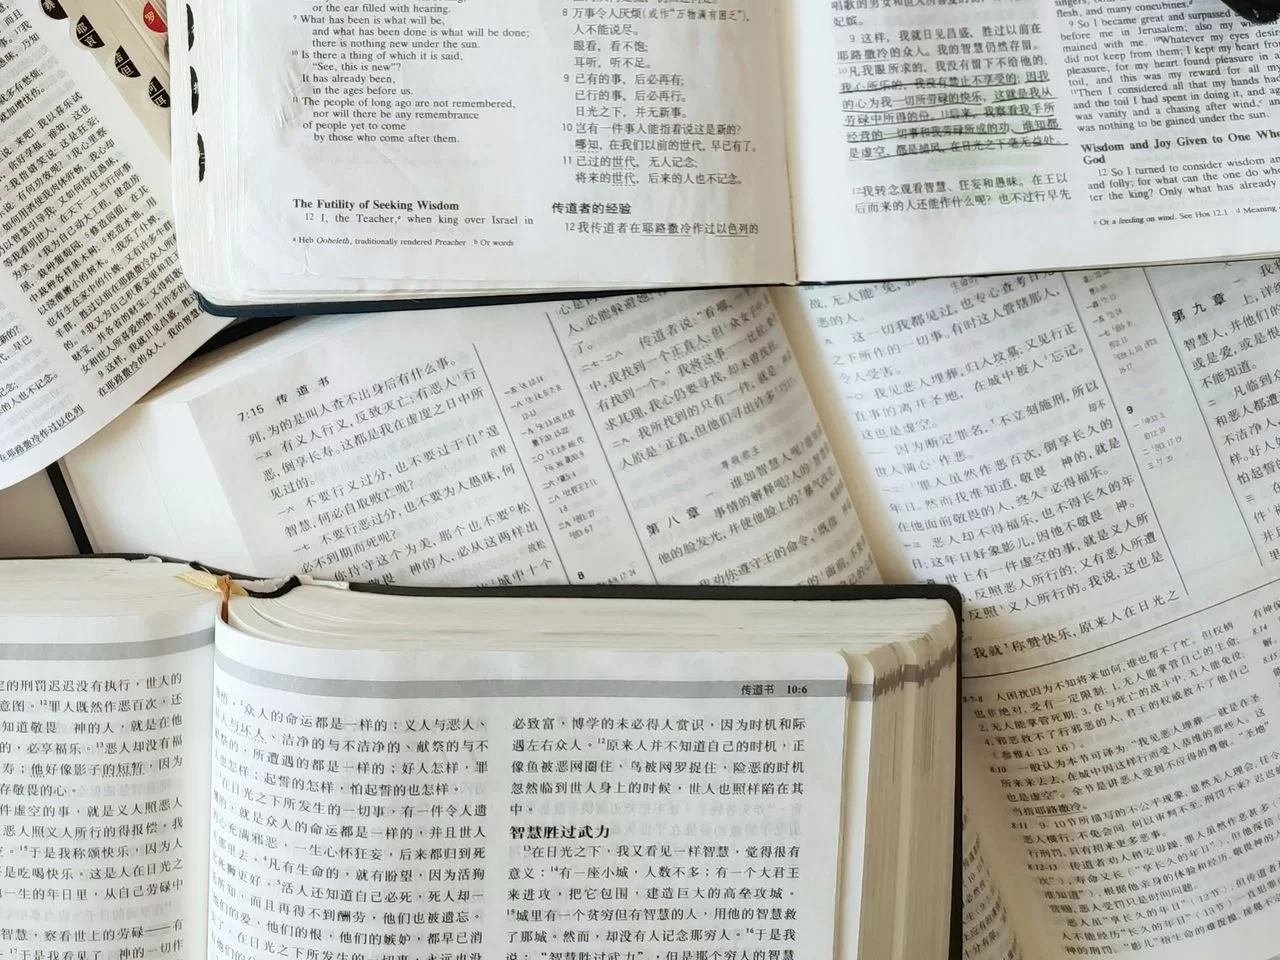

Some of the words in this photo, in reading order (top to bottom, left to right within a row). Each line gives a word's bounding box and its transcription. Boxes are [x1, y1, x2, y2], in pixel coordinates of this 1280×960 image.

[564, 74, 569, 83] 9
[1077, 124, 1095, 132] was
[1099, 121, 1134, 131] nothing
[1138, 120, 1147, 128] to
[1151, 118, 1162, 127] be
[1166, 116, 1196, 128] gained
[1199, 114, 1226, 124] under
[1230, 113, 1245, 121] the
[1249, 111, 1269, 120] sun.
[314, 133, 324, 142] by
[329, 133, 352, 142] those
[357, 133, 376, 142] who
[408, 134, 429, 142] after
[434, 134, 459, 143] them.
[1081, 141, 1124, 153] Wisdom
[1130, 140, 1148, 150] and
[1154, 138, 1171, 149] Joy
[1177, 136, 1207, 147] Given
[1213, 135, 1223, 144] to
[1228, 133, 1250, 143] One
[1083, 155, 1105, 165] God
[293, 199, 312, 209] The
[318, 199, 354, 211] Futility
[359, 200, 369, 210] of
[373, 200, 413, 211] Seeking
[417, 201, 459, 210] Wisdom
[552, 203, 632, 215] 传道者的经验
[355, 238, 397, 246] traditionally
[1172, 292, 1226, 324] 第九章
[1201, 360, 1257, 389] 不能知道。
[237, 405, 265, 422] 7:15
[1126, 406, 1133, 414] 9
[646, 506, 700, 537] 第八章
[577, 571, 585, 580] 8
[741, 684, 774, 696] 传道书
[786, 684, 808, 695] 10:6
[510, 825, 610, 840] 智慧胜过武力
